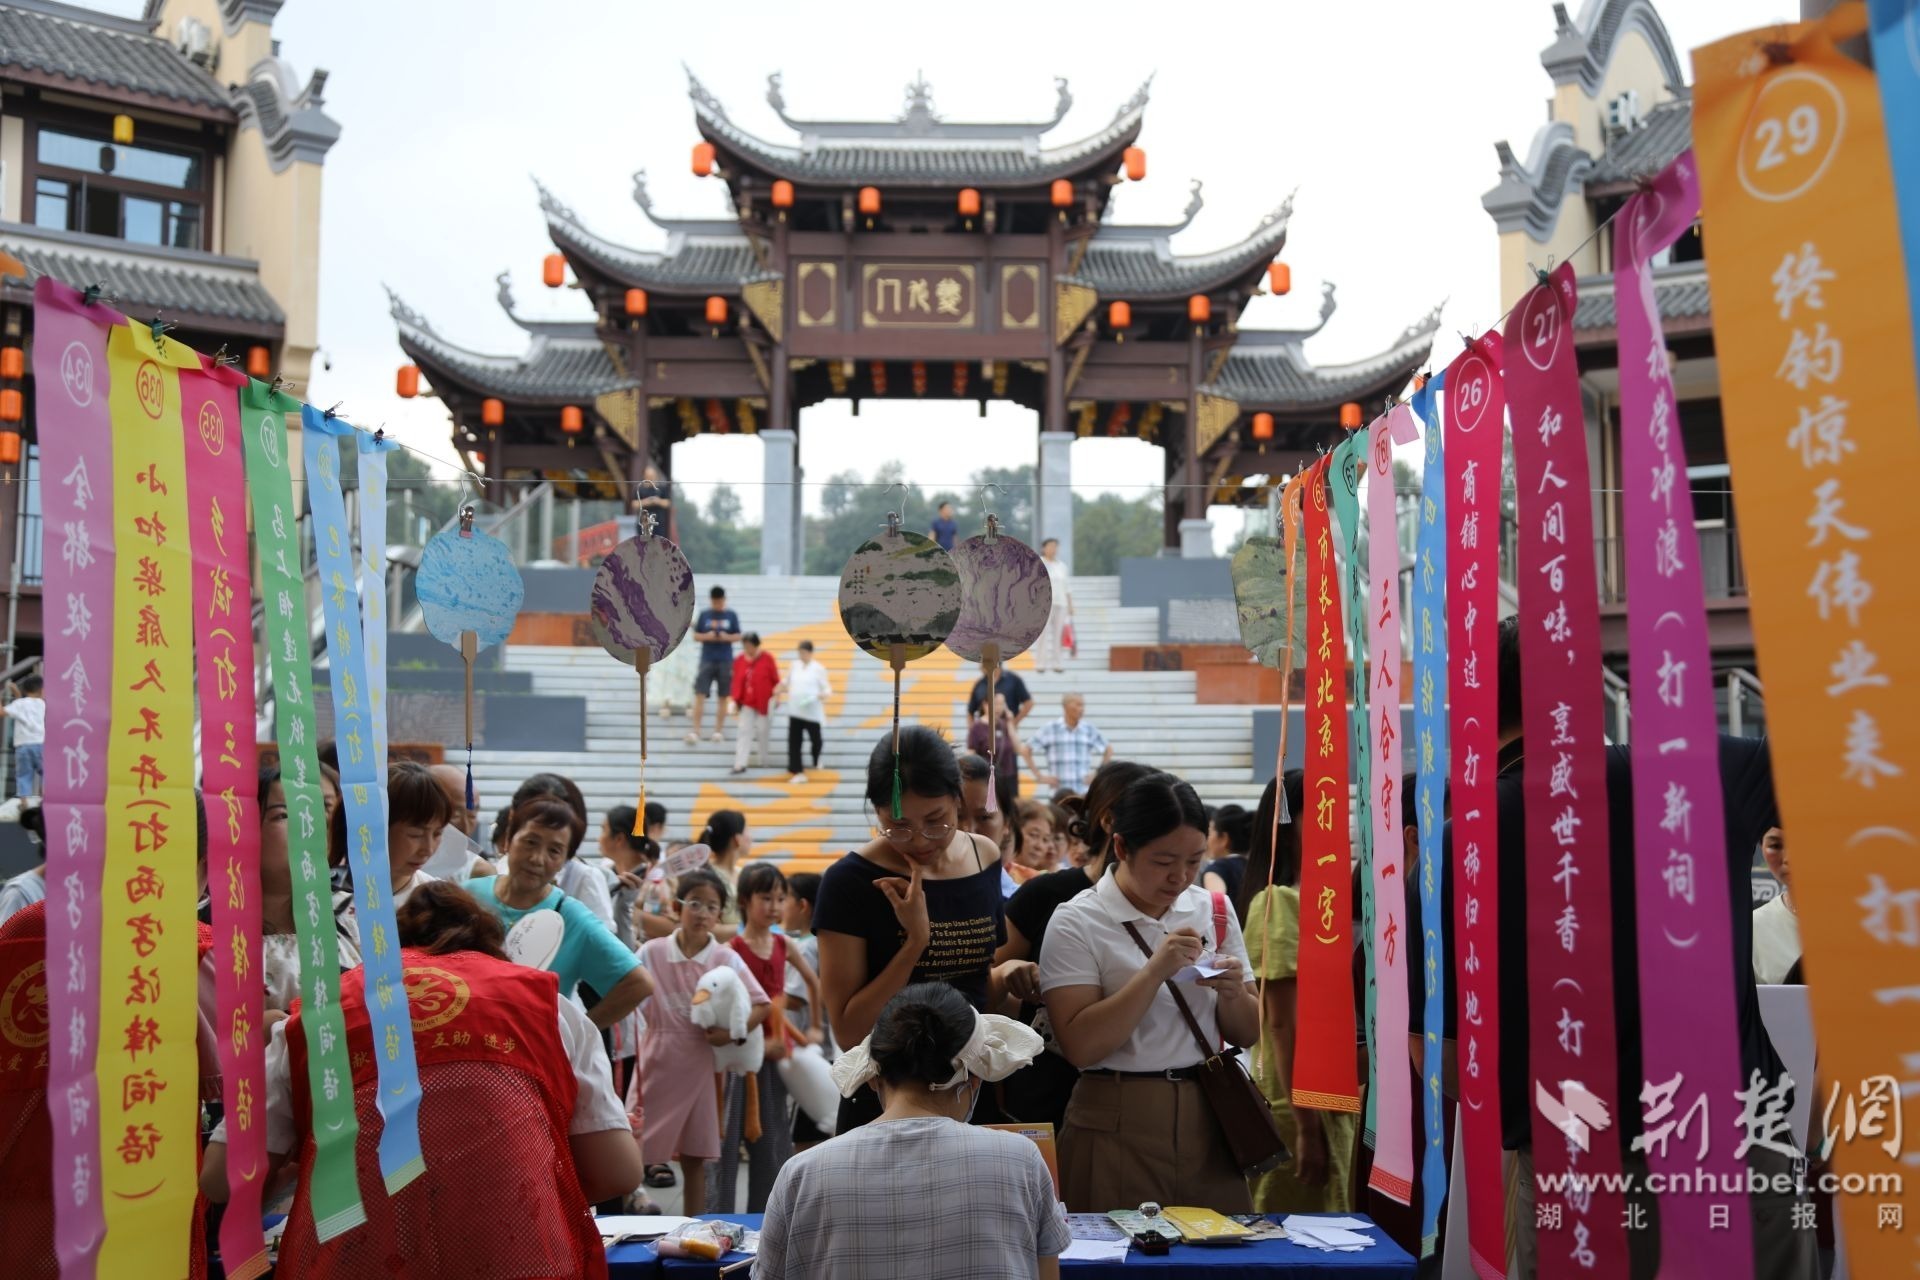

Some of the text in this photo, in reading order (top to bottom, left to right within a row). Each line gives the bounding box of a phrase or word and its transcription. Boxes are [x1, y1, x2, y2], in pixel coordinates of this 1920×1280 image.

[1754, 104, 1820, 172] 29
[1533, 305, 1556, 348] 27
[1460, 378, 1483, 412] 26
[1315, 527, 1340, 945] 市长去北京（打一字）
[1460, 458, 1485, 1113] 商铺心中过（打一秭归小地名）
[431, 1031, 471, 1049] 互助
[484, 1033, 516, 1055] 进步
